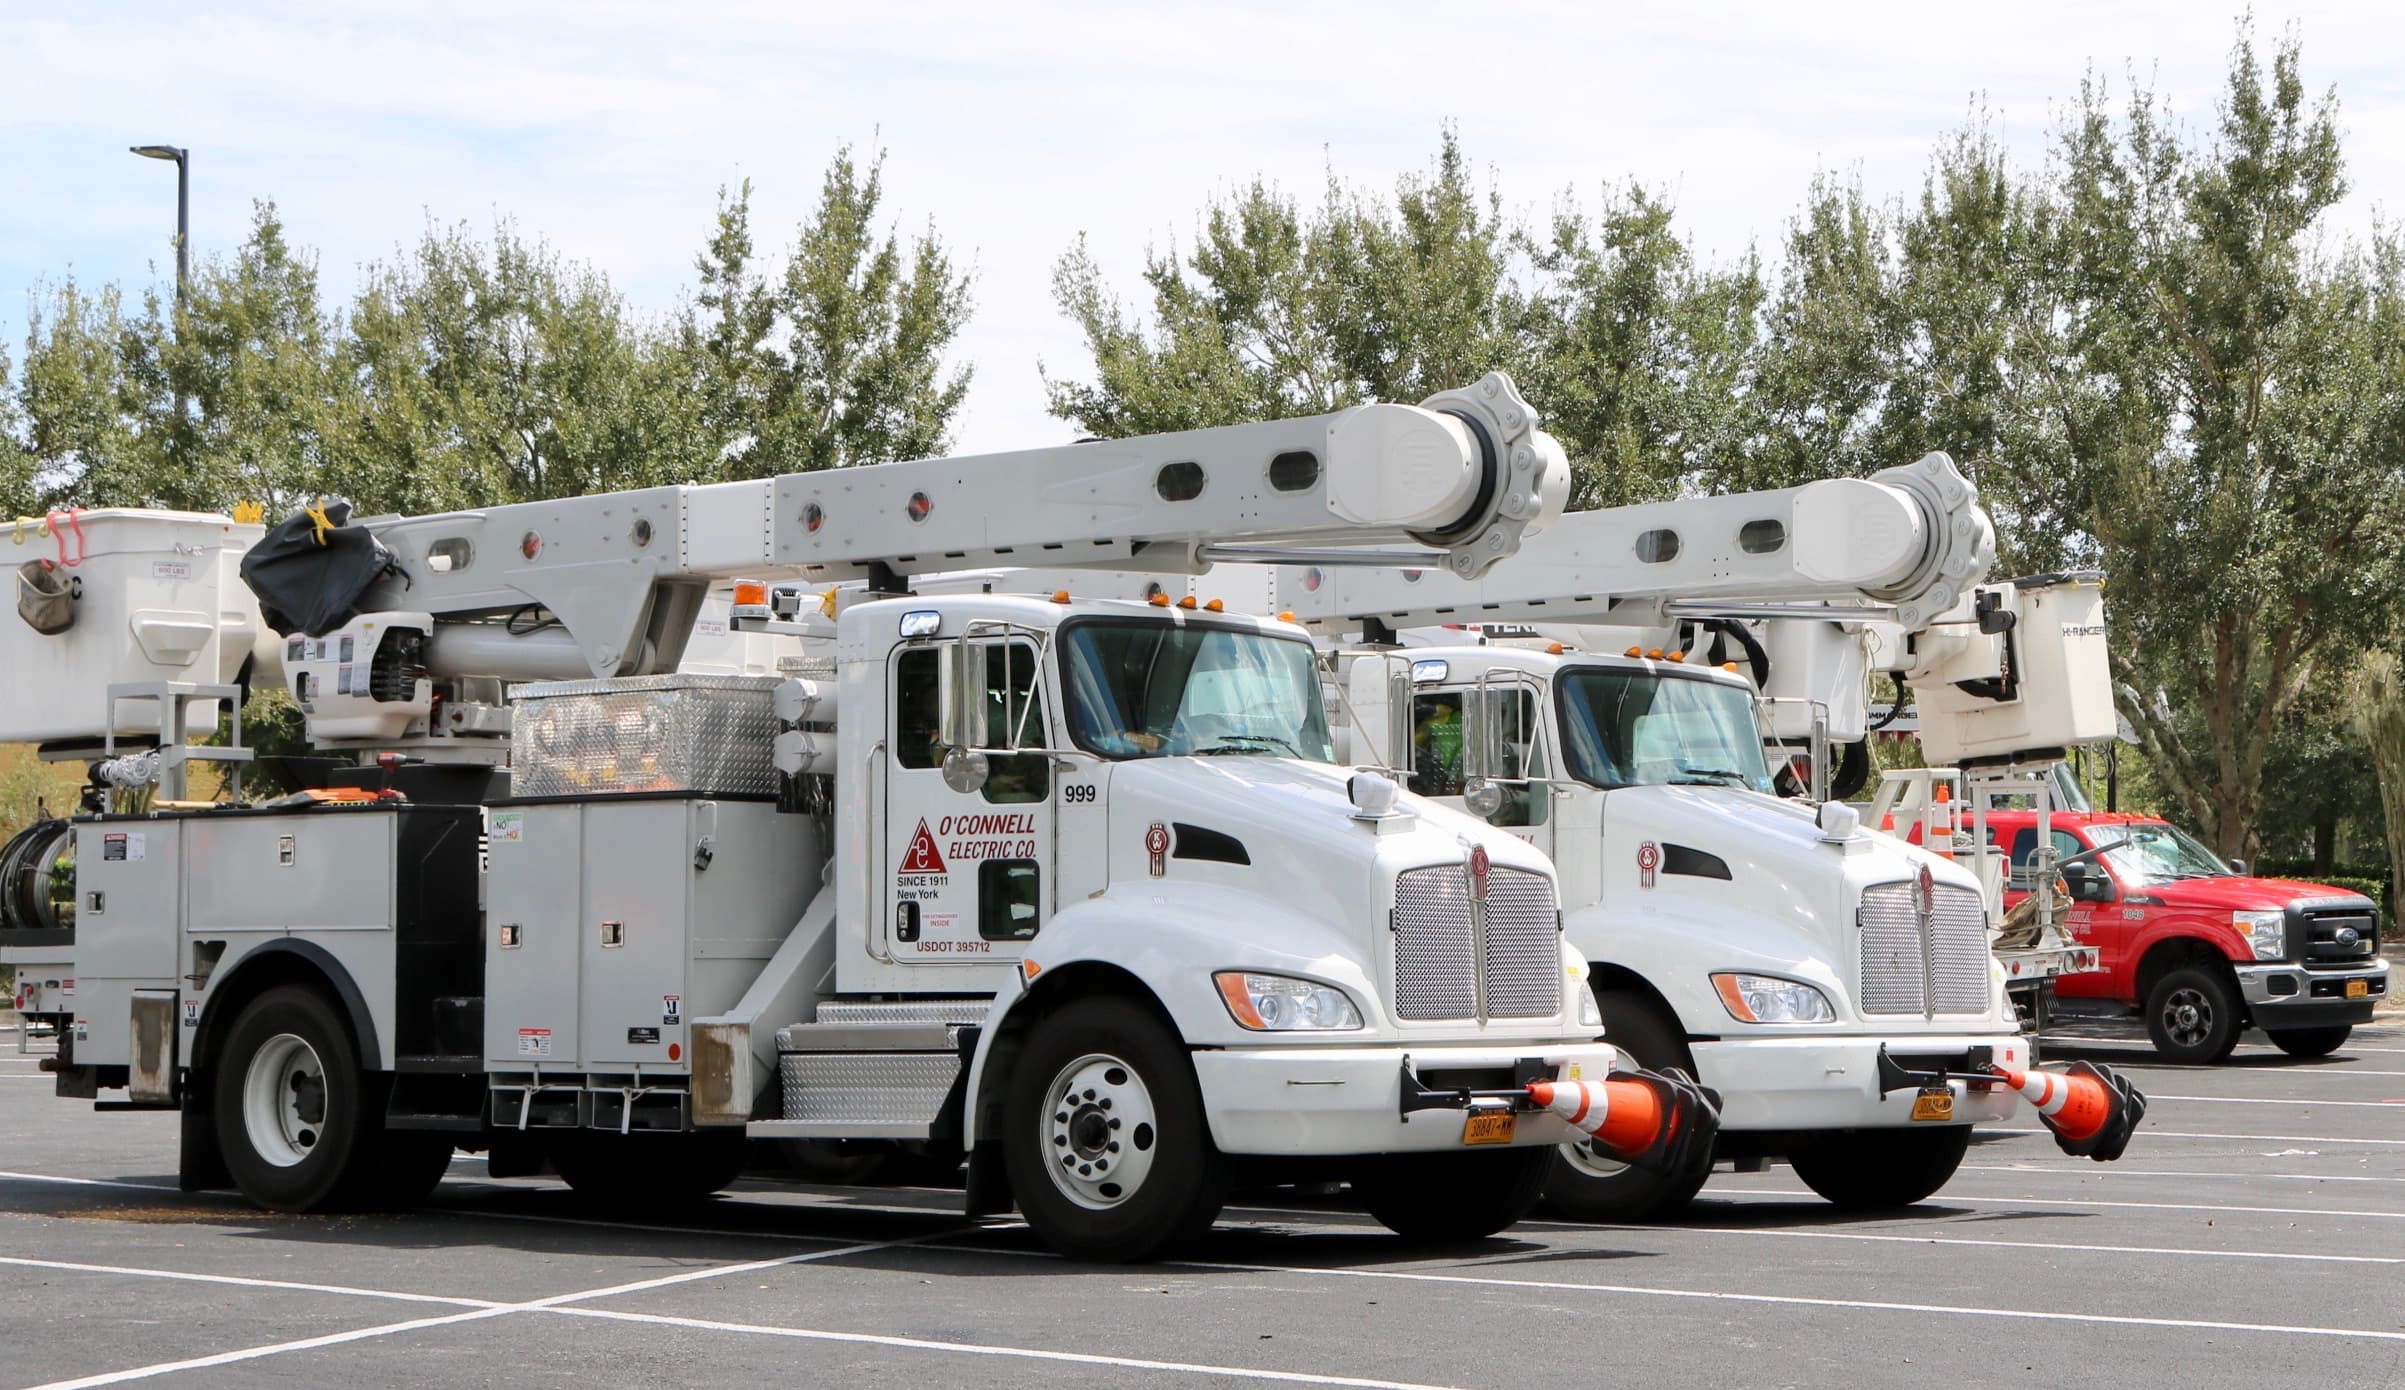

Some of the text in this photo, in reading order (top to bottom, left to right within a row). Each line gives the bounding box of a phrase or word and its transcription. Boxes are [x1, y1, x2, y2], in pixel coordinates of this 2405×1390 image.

[1065, 785, 1096, 803] 999
[939, 814, 1036, 836] O'CONNELL
[948, 840, 1037, 859] ELECTRIC CO.
[897, 876, 948, 887] SINCE 1911
[897, 889, 939, 900] New York
[917, 942, 991, 953] USDOT 395712
